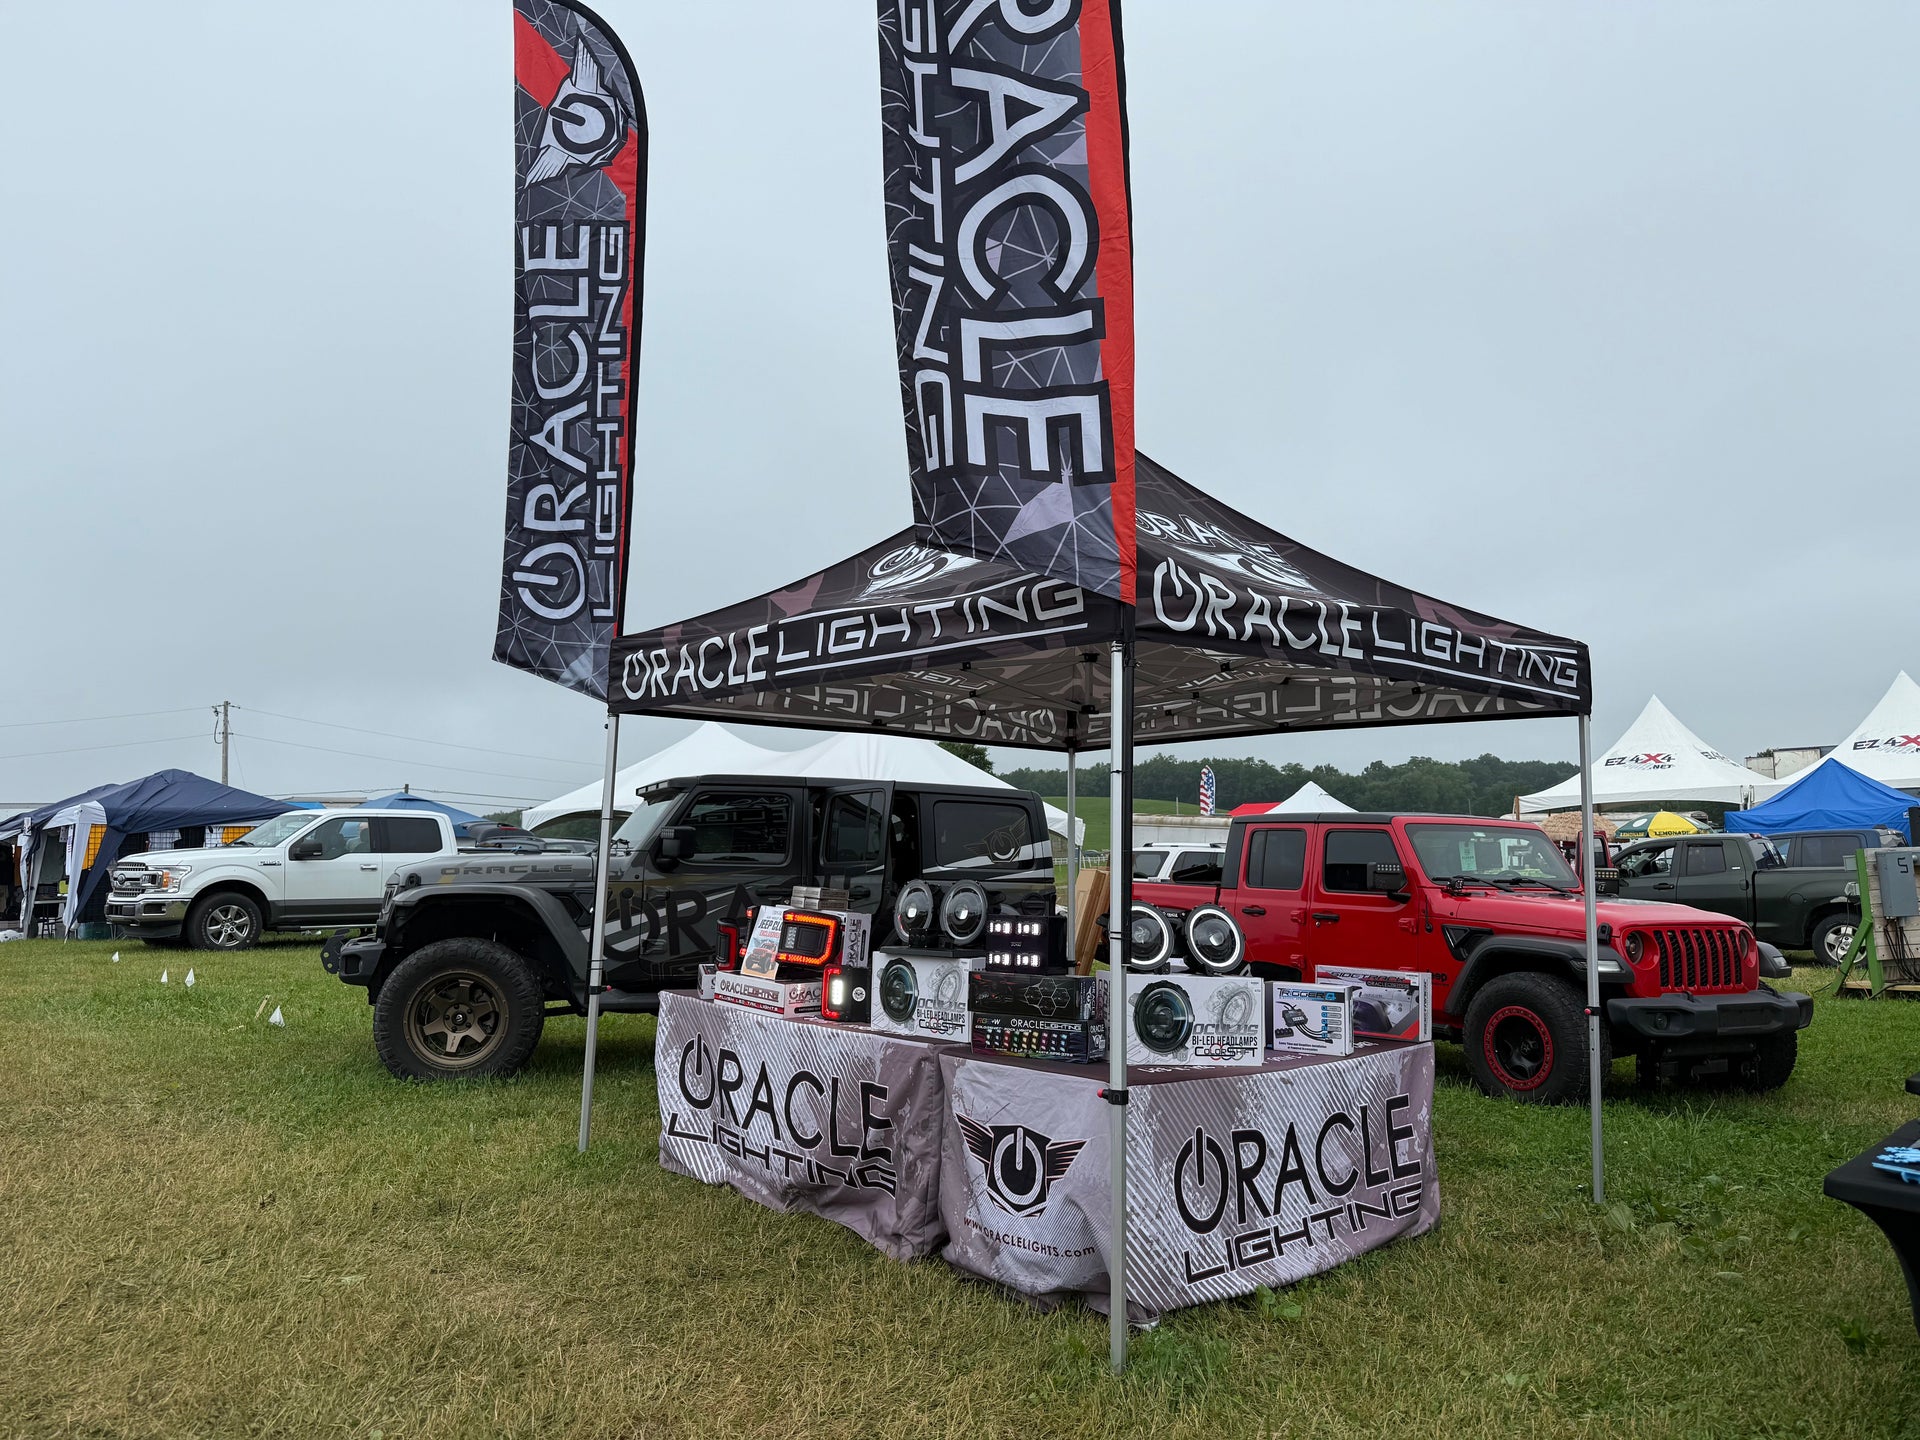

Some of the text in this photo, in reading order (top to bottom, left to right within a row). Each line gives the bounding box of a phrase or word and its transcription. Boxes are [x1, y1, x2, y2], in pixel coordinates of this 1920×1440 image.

[512, 224, 591, 623] ORACLE
[591, 225, 625, 618] LIGHTING
[621, 578, 1085, 701] ORACLE LIGHTING
[1152, 556, 1578, 688] ORACLE LIGHTING
[440, 863, 574, 877] ORACLE
[847, 918, 858, 968] ORACLE
[720, 980, 746, 996] ORACLE
[916, 1008, 966, 1024] BI-LED HEADLAMPS
[1010, 1018, 1045, 1030] ORACLE
[1192, 1023, 1259, 1036] OCULUS
[1191, 1035, 1258, 1047] BI-LED HEADLAMPS
[679, 1032, 894, 1164] ORACLE
[667, 1112, 897, 1200] LIGHTING
[1173, 1094, 1422, 1234] ORACLE
[1183, 1181, 1422, 1286] LIGHTING
